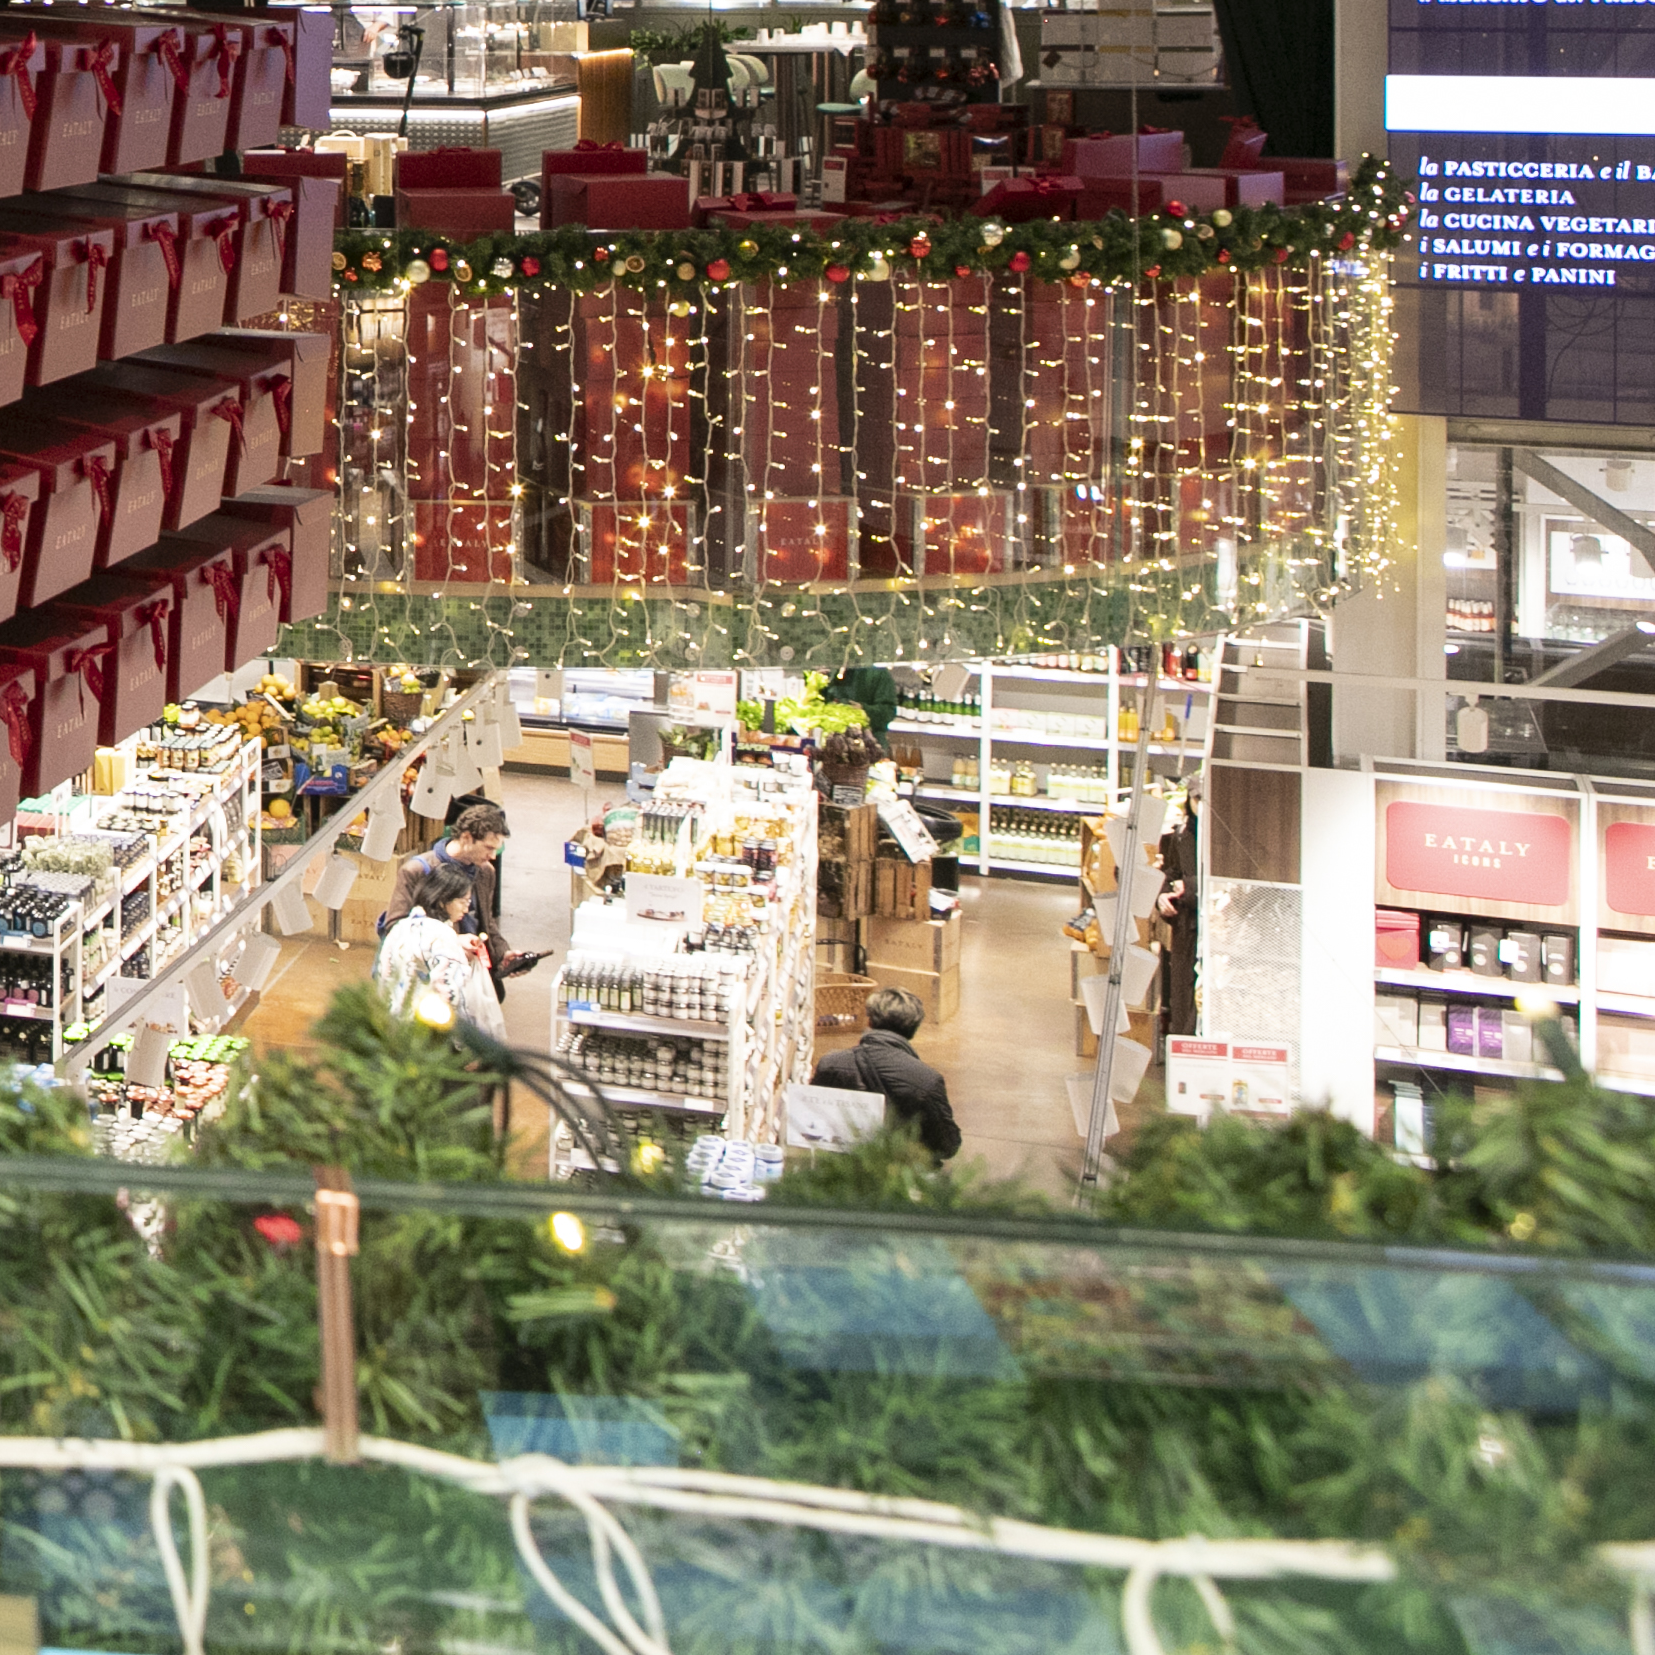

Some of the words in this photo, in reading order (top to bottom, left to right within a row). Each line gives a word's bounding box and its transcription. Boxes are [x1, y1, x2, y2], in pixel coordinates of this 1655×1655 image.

[1419, 156, 1438, 177] la
[1443, 160, 1595, 180] PASTICCERIA
[1599, 165, 1612, 181] e
[1615, 160, 1631, 181] il
[1419, 181, 1438, 203] la
[1443, 186, 1576, 205] GELATERIA
[1419, 208, 1438, 230] la
[1443, 213, 1535, 232] CUCINA
[1419, 236, 1428, 255] i
[1432, 238, 1522, 257] SALUMI
[1526, 243, 1539, 258] e
[1542, 240, 1551, 258] i
[1419, 261, 1428, 280] i
[1432, 263, 1508, 282] FRITTI
[1512, 270, 1525, 283] e
[1530, 267, 1616, 286] PANINI
[1424, 832, 1532, 858] EATALY
[1453, 853, 1502, 870] ICONS
